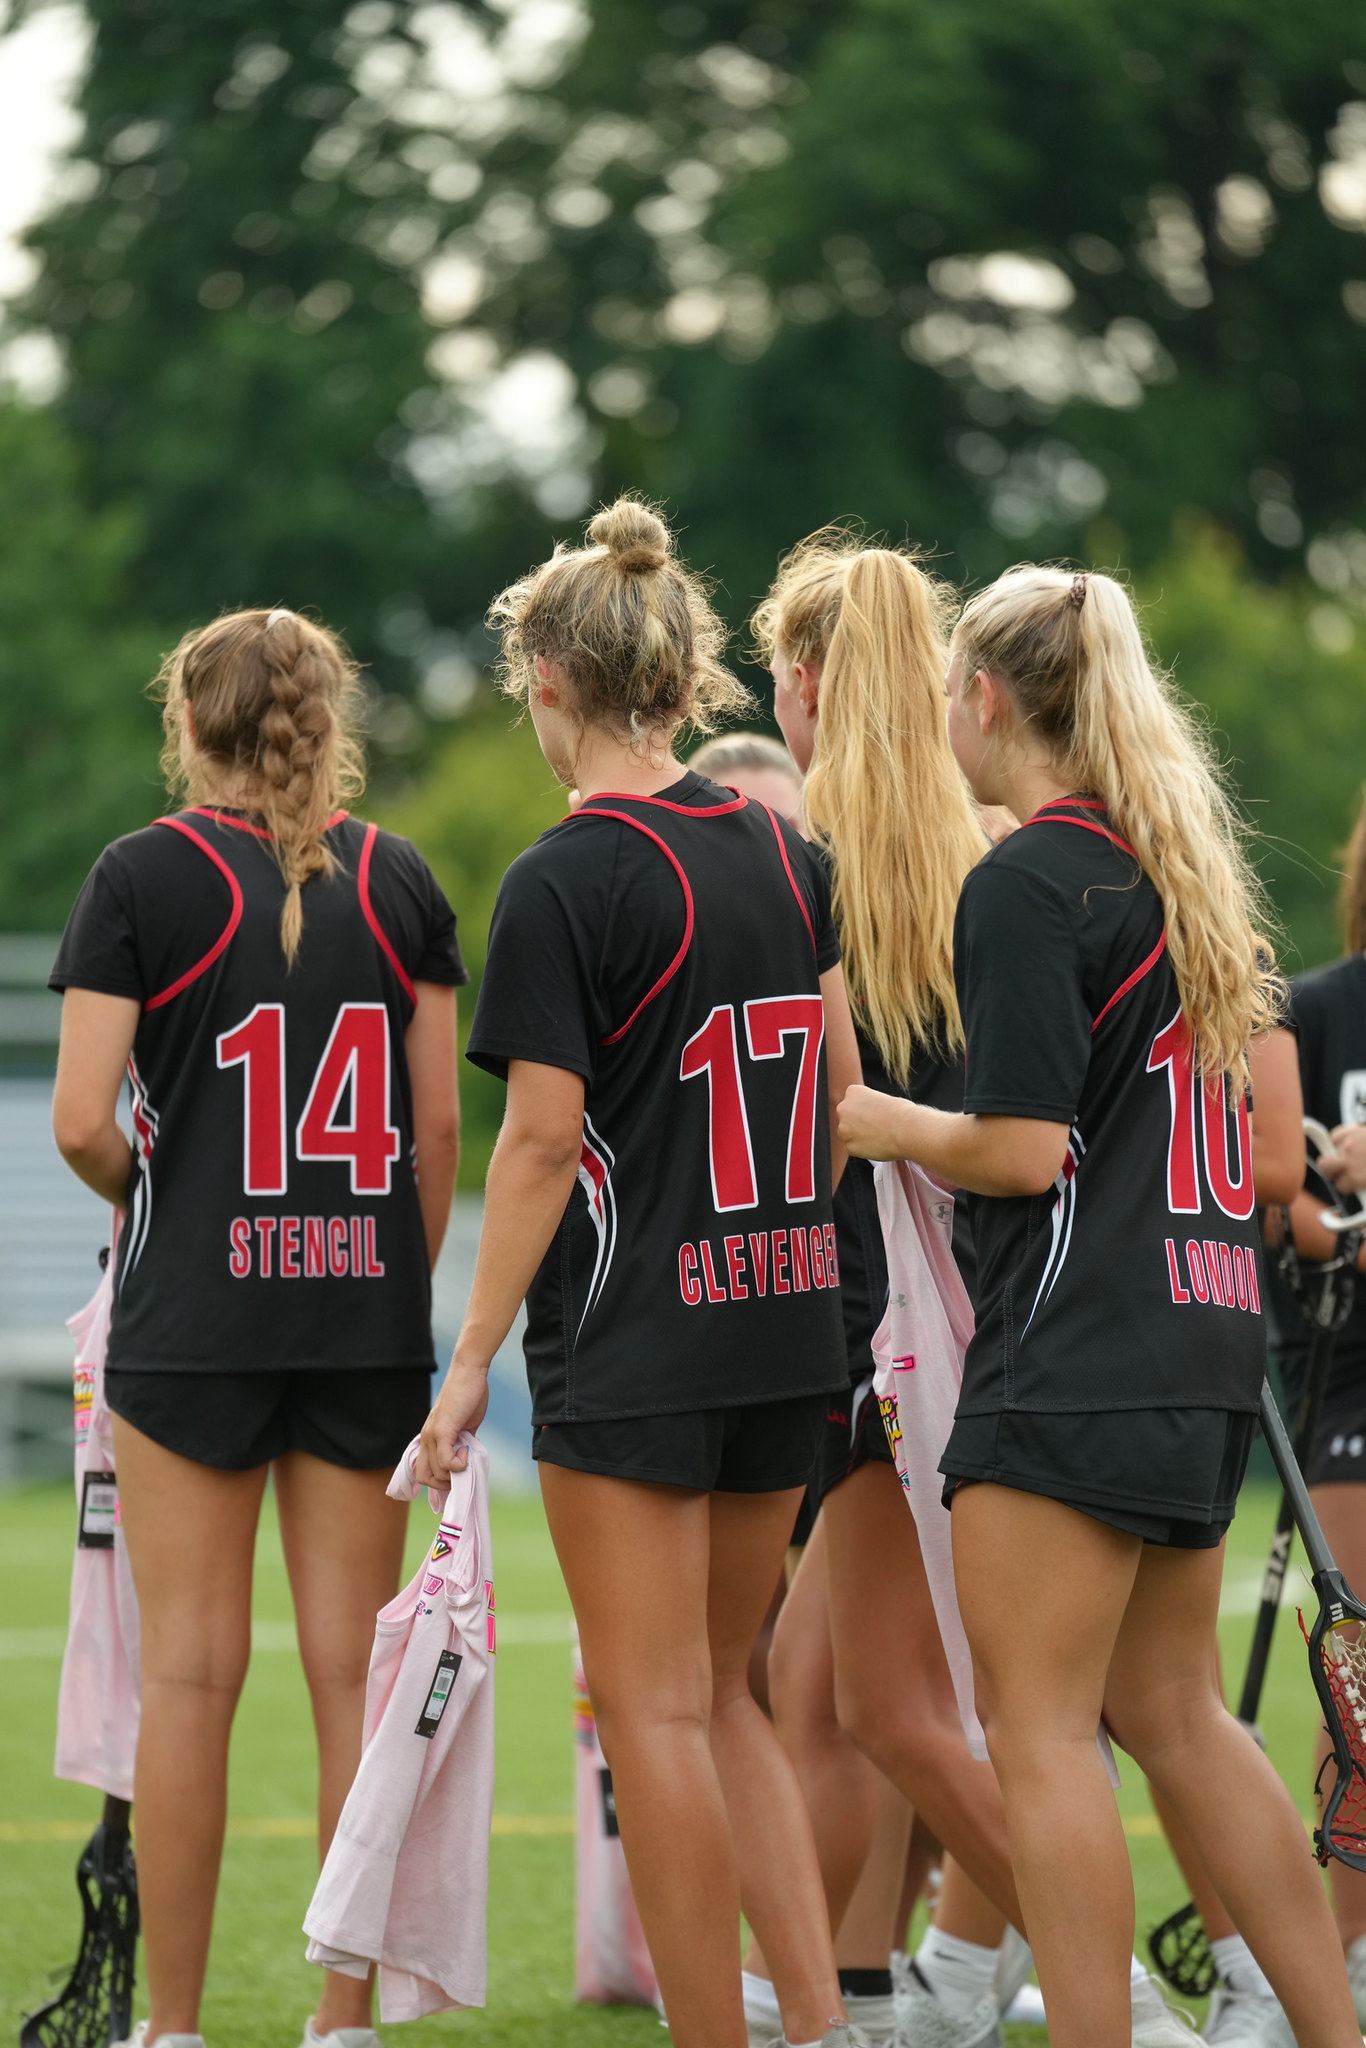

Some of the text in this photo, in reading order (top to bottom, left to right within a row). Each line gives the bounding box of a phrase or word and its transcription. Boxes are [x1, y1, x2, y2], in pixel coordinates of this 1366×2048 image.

[216, 1001, 400, 1196] 14
[679, 994, 825, 1213] 17
[1145, 1004, 1256, 1221] 10
[229, 1215, 385, 1278] STENCIL
[1164, 1238, 1262, 1315] LONDON
